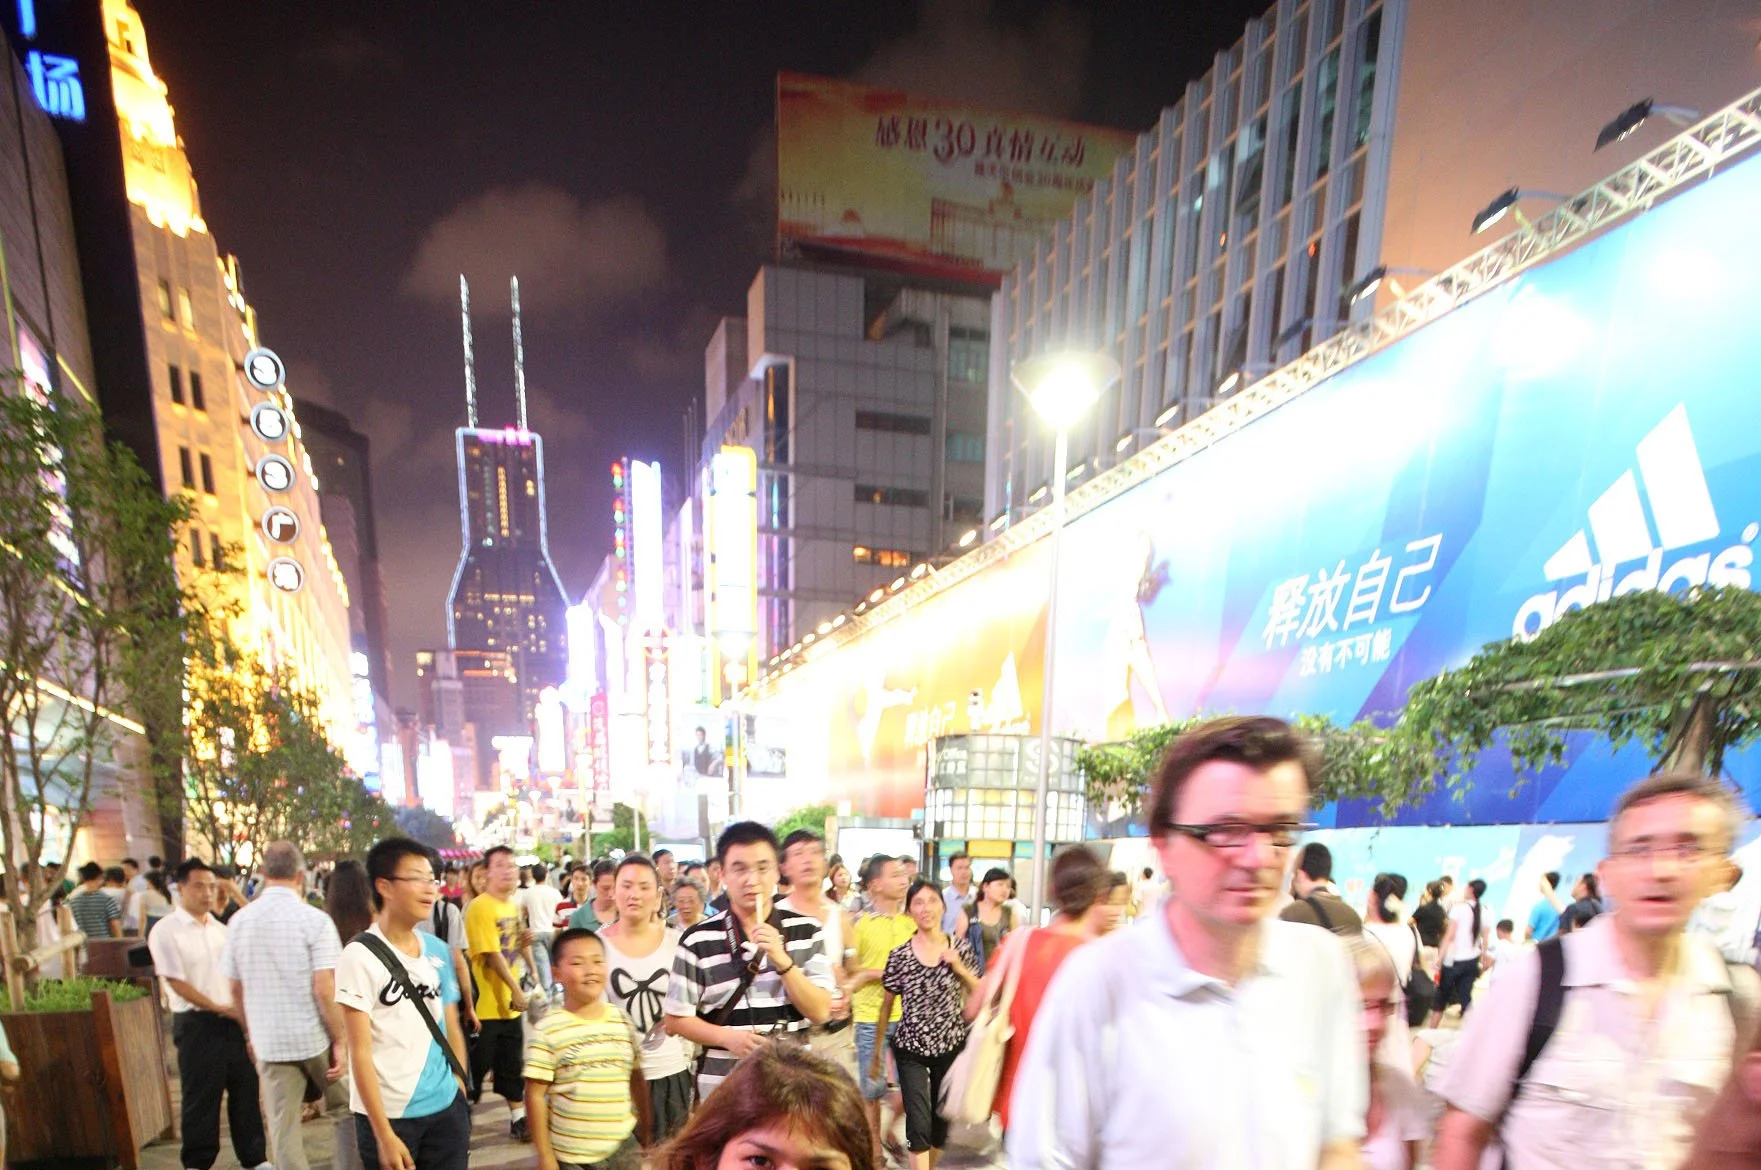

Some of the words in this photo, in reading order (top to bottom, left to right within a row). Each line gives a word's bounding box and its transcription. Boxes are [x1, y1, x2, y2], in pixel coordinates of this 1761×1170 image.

[1262, 532, 1443, 649] 释放自己
[1511, 546, 1754, 644] adidas
[1300, 628, 1392, 677] 没有不可能
